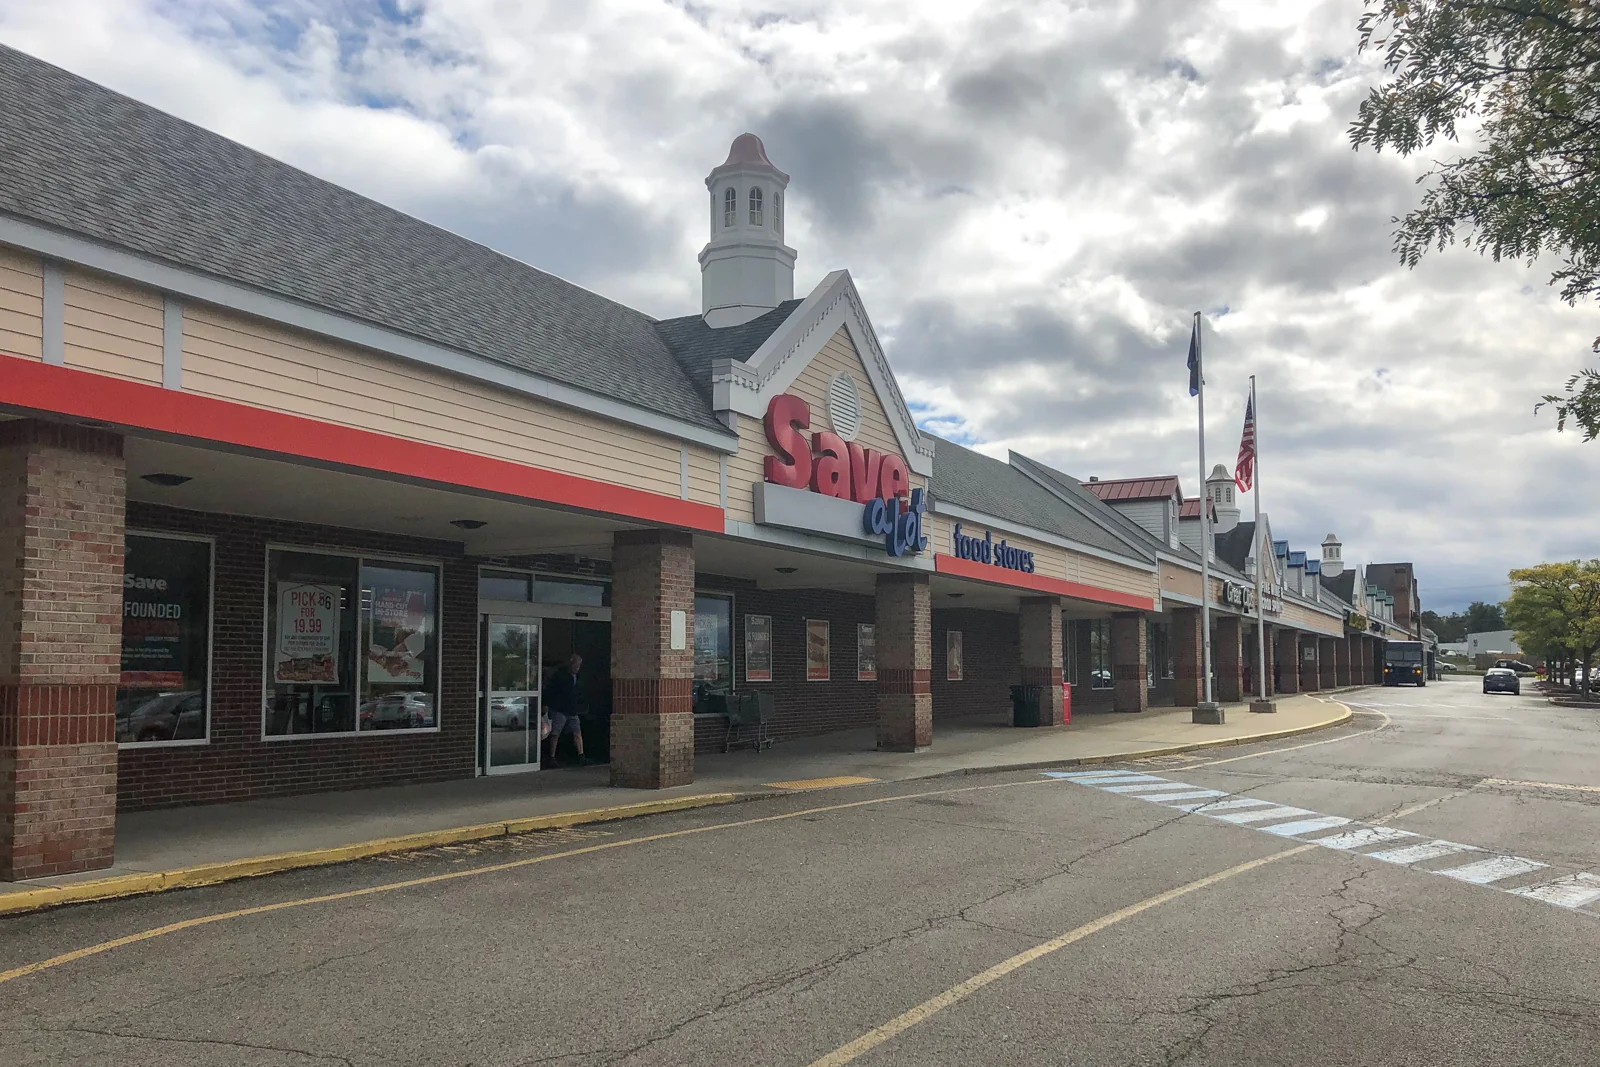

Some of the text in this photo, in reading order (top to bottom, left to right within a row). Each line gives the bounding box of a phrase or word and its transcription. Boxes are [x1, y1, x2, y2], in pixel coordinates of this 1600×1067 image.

[764, 394, 909, 514] Save
[954, 523, 1034, 573] food stores
[123, 573, 168, 591] Save
[291, 592, 316, 607] PICK
[124, 602, 181, 619] FOUNDED
[301, 607, 315, 617] FOR
[294, 619, 322, 633] 19.99
